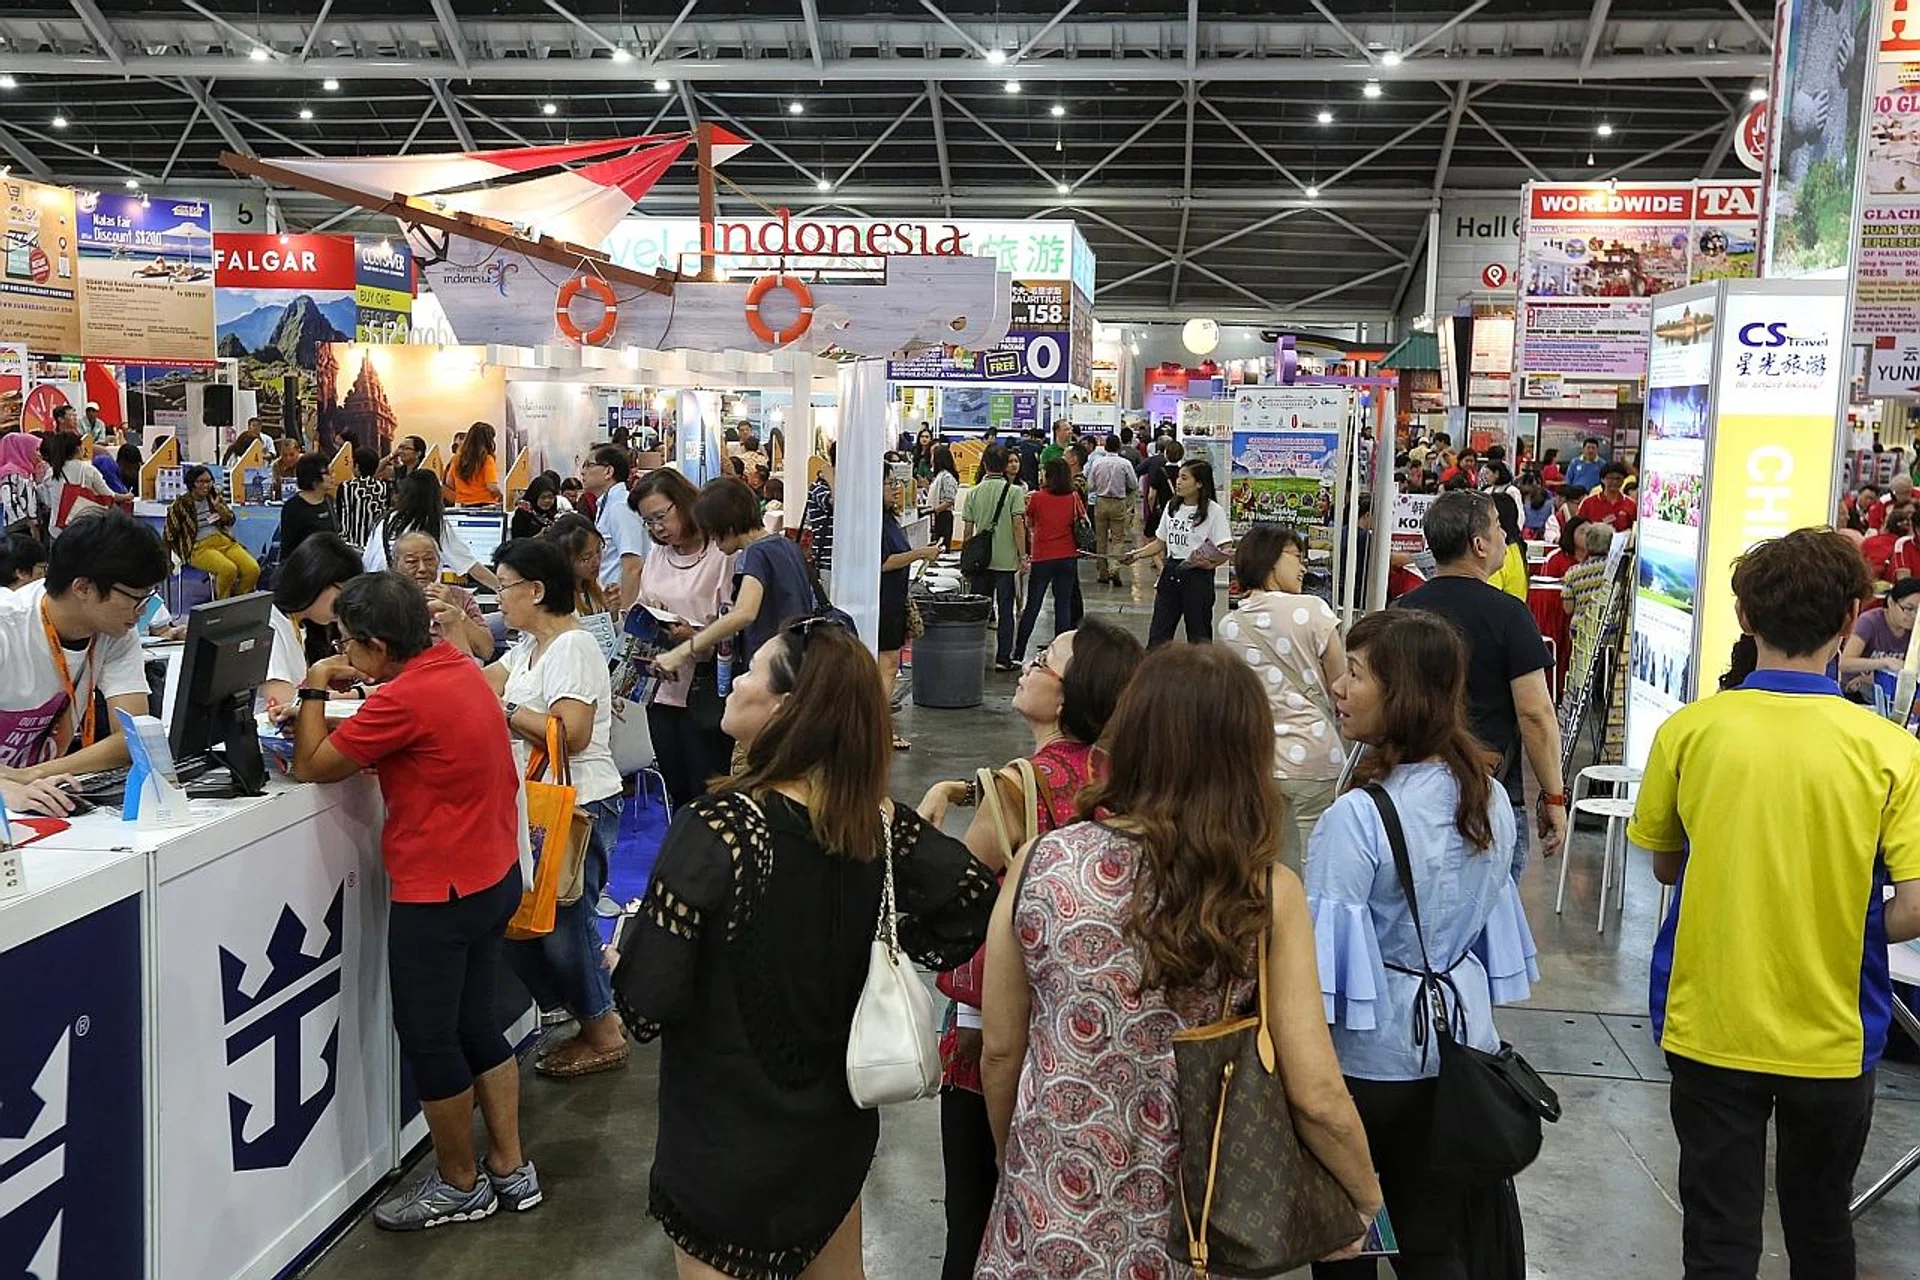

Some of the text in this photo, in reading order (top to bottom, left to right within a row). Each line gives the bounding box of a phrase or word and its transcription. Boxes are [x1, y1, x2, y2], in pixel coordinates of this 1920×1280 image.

[1541, 196, 1683, 213] WORLDWIDE
[94, 227, 132, 242] Discount
[1456, 216, 1506, 238] Hall
[360, 290, 391, 306] BUY ONE
[1028, 304, 1062, 324] 158
[1738, 322, 1828, 347] CS Travel
[990, 361, 1015, 373] FREE
[1736, 353, 1827, 377] 星光旅游
[167, 449, 173, 461] 3
[253, 453, 259, 464] 4
[344, 457, 349, 467] 5
[1740, 444, 1795, 553] CHI
[19, 717, 38, 727] OUT
[5, 731, 25, 746] IN
